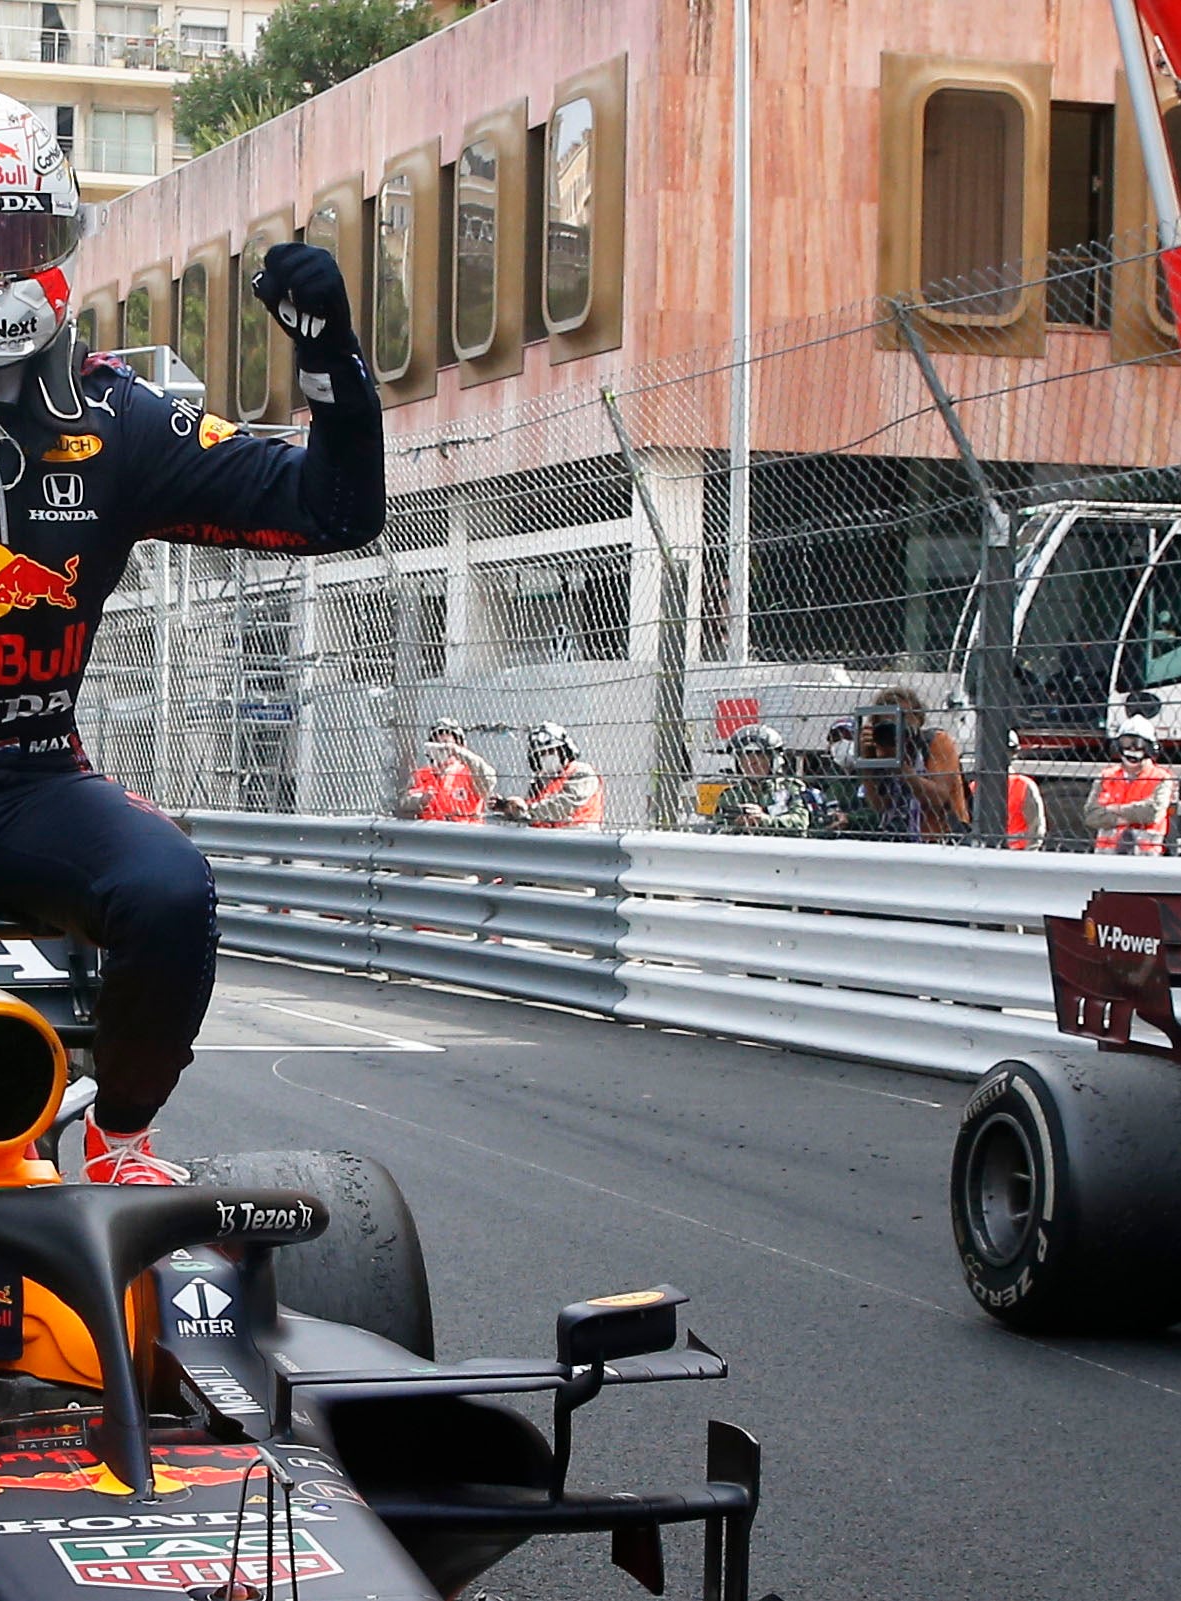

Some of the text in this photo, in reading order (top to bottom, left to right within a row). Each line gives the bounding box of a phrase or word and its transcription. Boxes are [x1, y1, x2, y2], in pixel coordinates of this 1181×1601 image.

[28, 509, 99, 522] HONDA
[29, 732, 71, 754] MAX
[1096, 923, 1161, 956] V-Power
[239, 1202, 297, 1231] Tezos
[972, 1265, 1034, 1308] ZERO
[177, 1319, 235, 1334] INTER
[193, 1377, 266, 1415] Mobil
[17, 1438, 83, 1450] RACING
[75, 1535, 296, 1557] TAG
